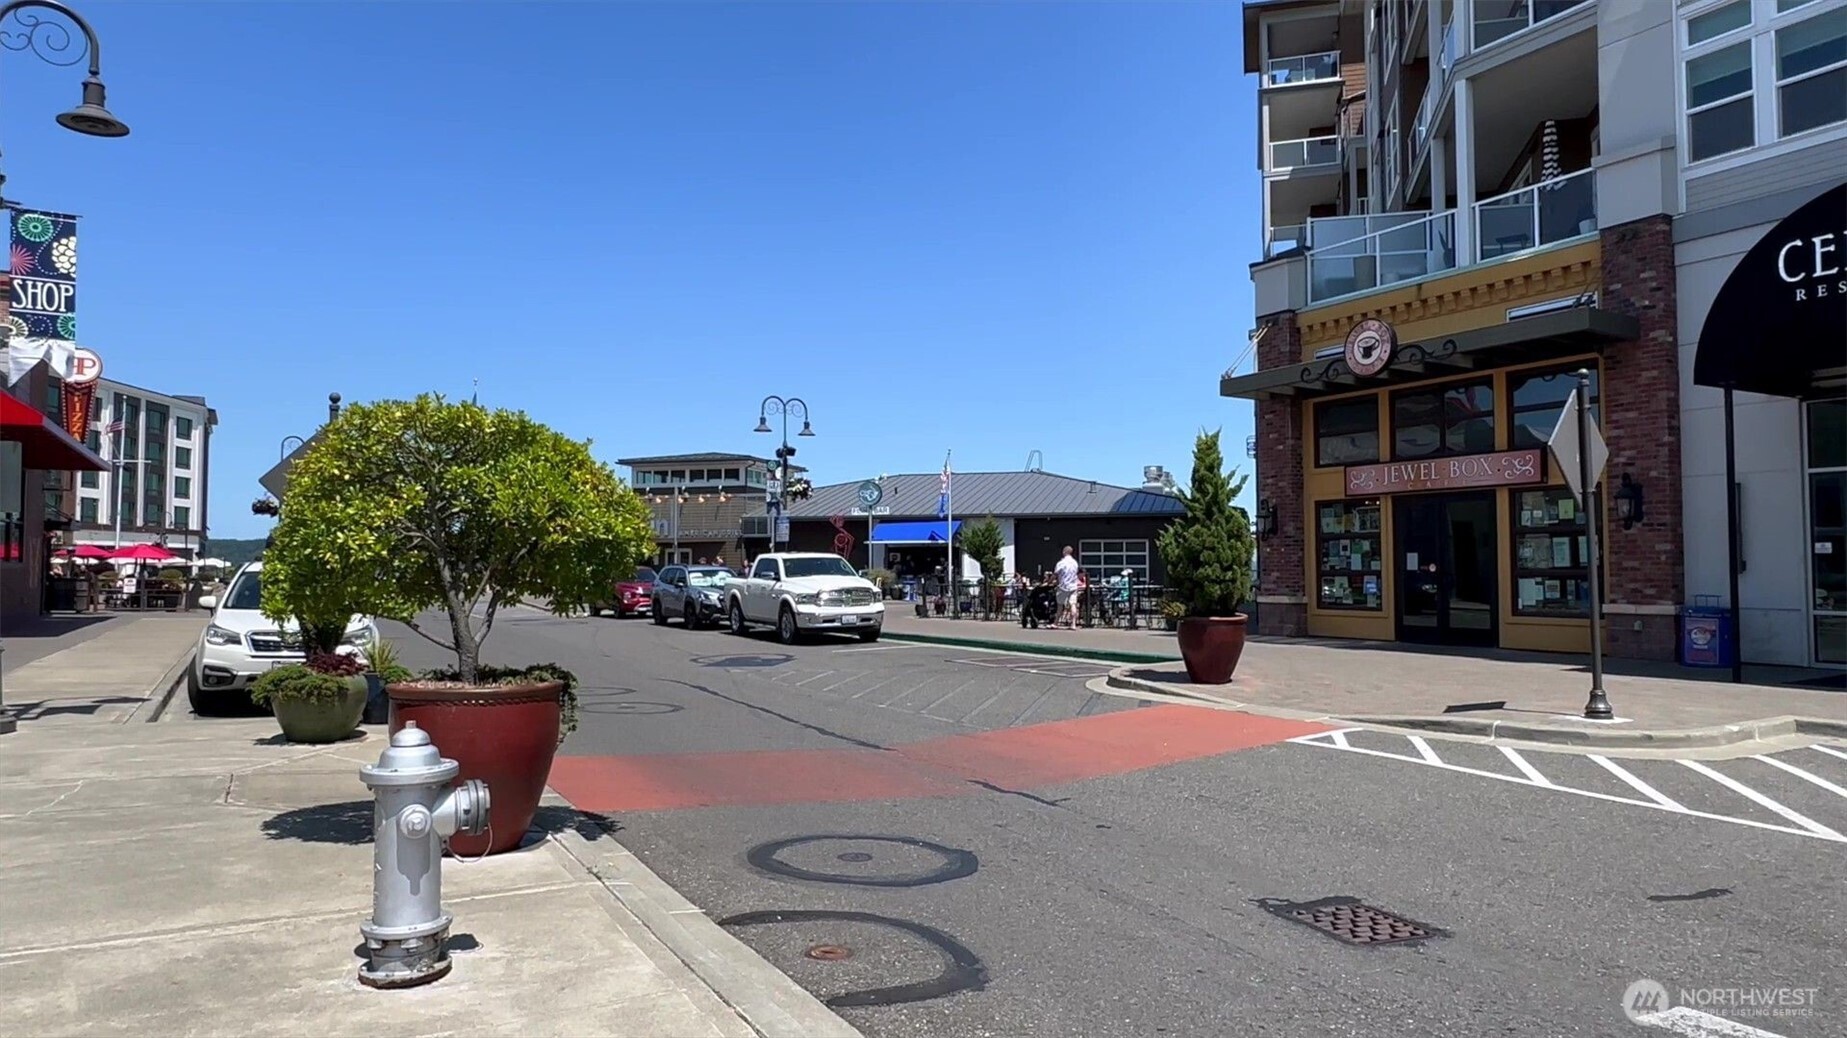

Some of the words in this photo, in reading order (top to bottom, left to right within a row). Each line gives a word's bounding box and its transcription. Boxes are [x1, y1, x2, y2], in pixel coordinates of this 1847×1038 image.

[1778, 230, 1847, 282] CE
[11, 279, 75, 313] SHOP
[1796, 280, 1847, 301] RES
[1382, 461, 1440, 485] JEWEL
[1449, 457, 1494, 478] BOX
